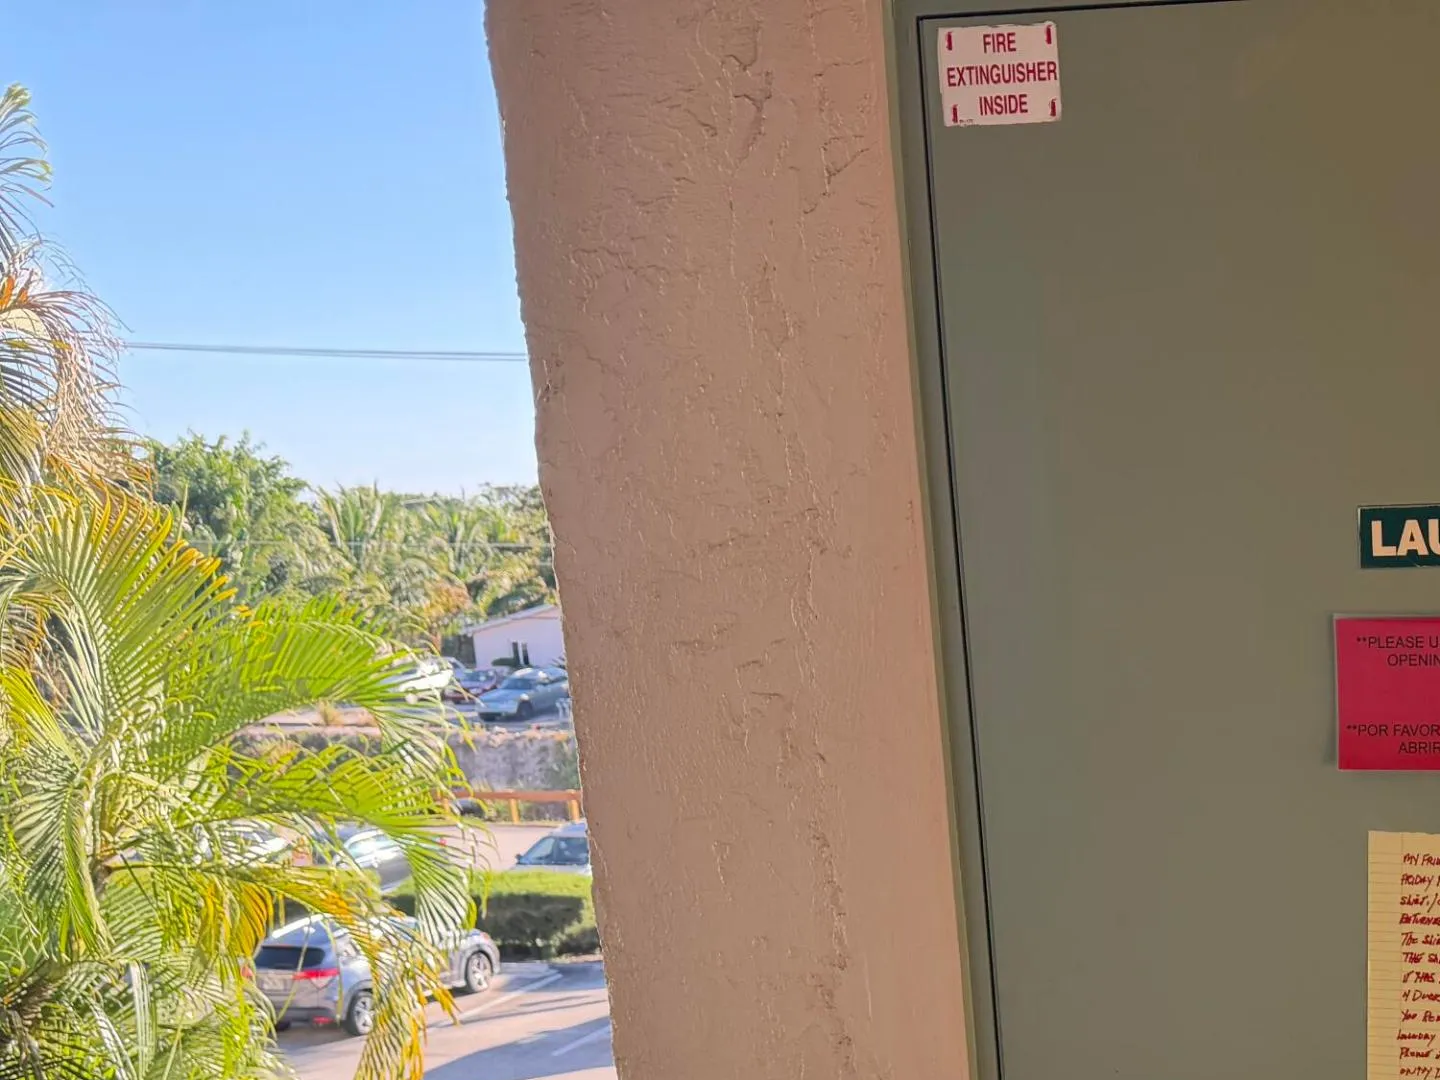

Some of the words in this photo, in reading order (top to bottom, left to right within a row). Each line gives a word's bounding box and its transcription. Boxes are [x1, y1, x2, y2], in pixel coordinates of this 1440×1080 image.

[982, 32, 1017, 54] FIRE
[946, 61, 1058, 87] EXTINGUISHER
[978, 94, 1028, 116] INSIDE
[1403, 853, 1420, 866] MY
[1400, 873, 1434, 892] FRIDAY
